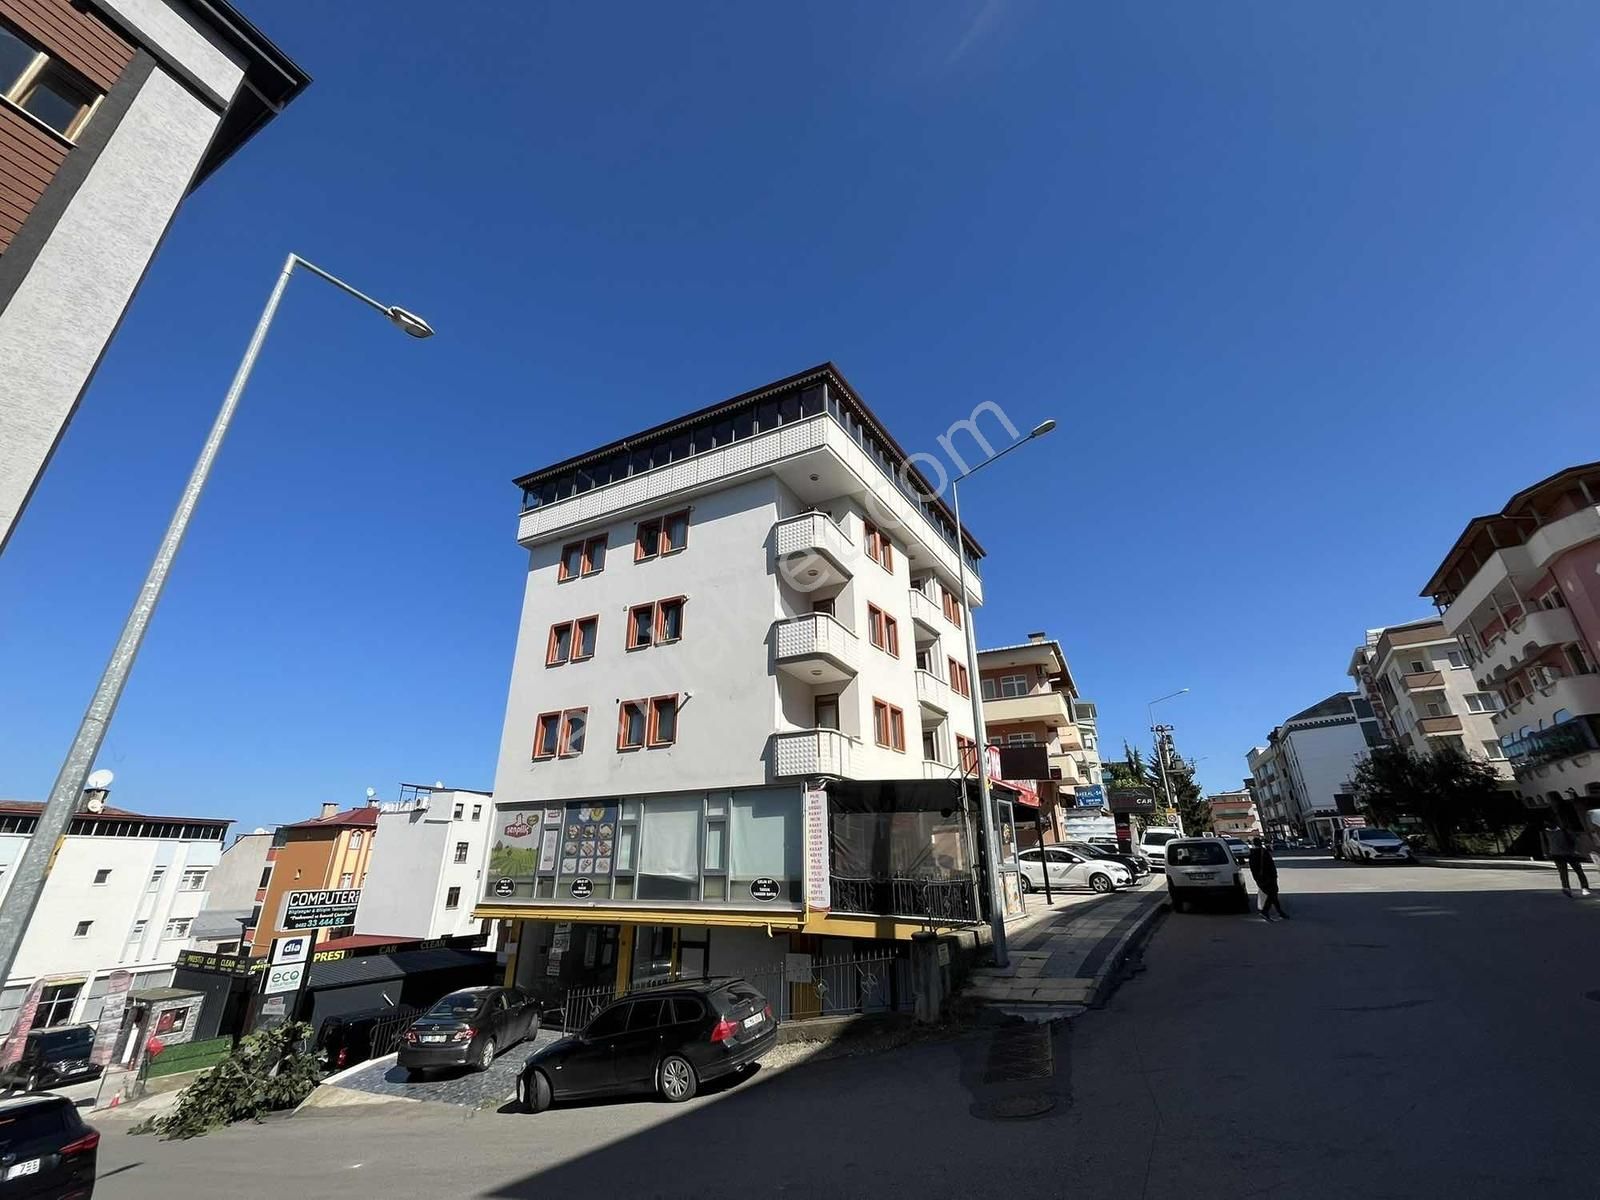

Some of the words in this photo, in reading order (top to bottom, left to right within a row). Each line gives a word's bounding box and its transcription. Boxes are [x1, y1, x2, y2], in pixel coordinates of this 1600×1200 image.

[289, 890, 356, 906] COMPUTER
[307, 919, 318, 927] 33
[271, 970, 300, 983] eco
